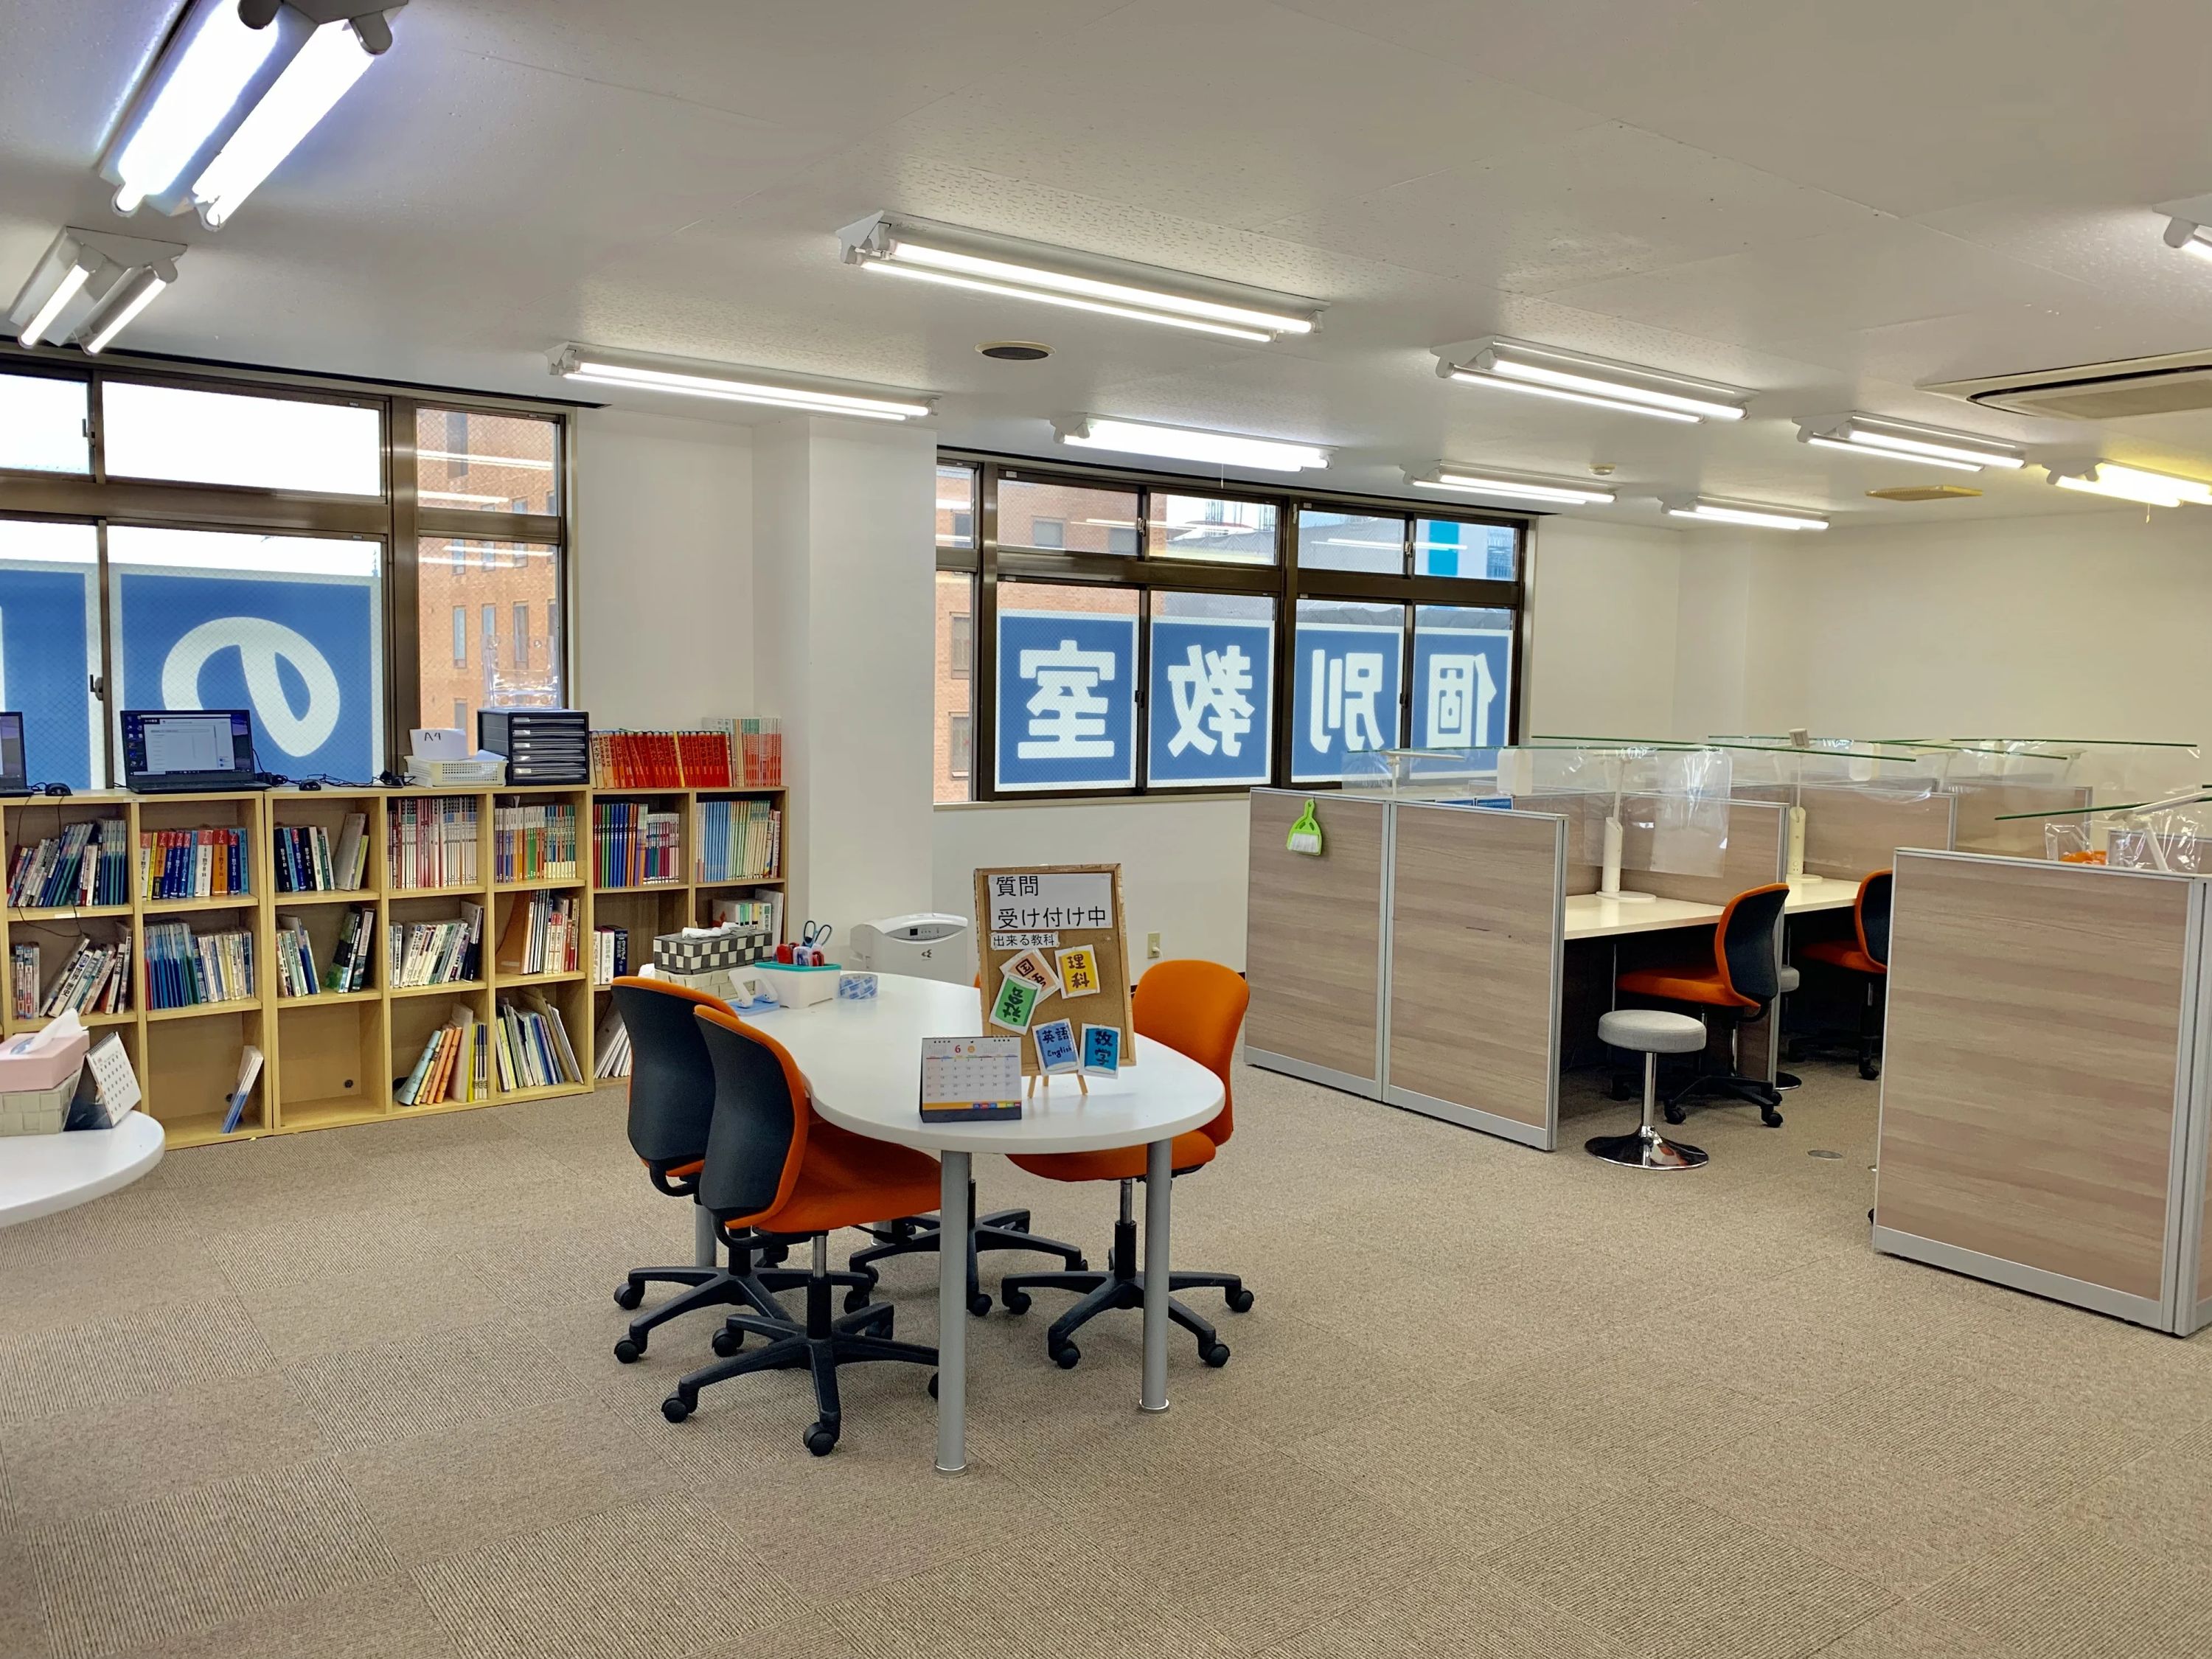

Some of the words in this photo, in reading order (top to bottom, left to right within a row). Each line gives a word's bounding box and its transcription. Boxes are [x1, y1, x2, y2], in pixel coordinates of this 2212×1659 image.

[996, 875, 1039, 897] 質問
[998, 905, 1106, 929] 受け付け中
[993, 933, 1055, 947] 出来る教科
[1066, 953, 1090, 989] 理科
[1042, 1027, 1069, 1044] 英語
[955, 1045, 961, 1054] 6
[1047, 1046, 1072, 1058] English
[1094, 1028, 1113, 1065] 数学
